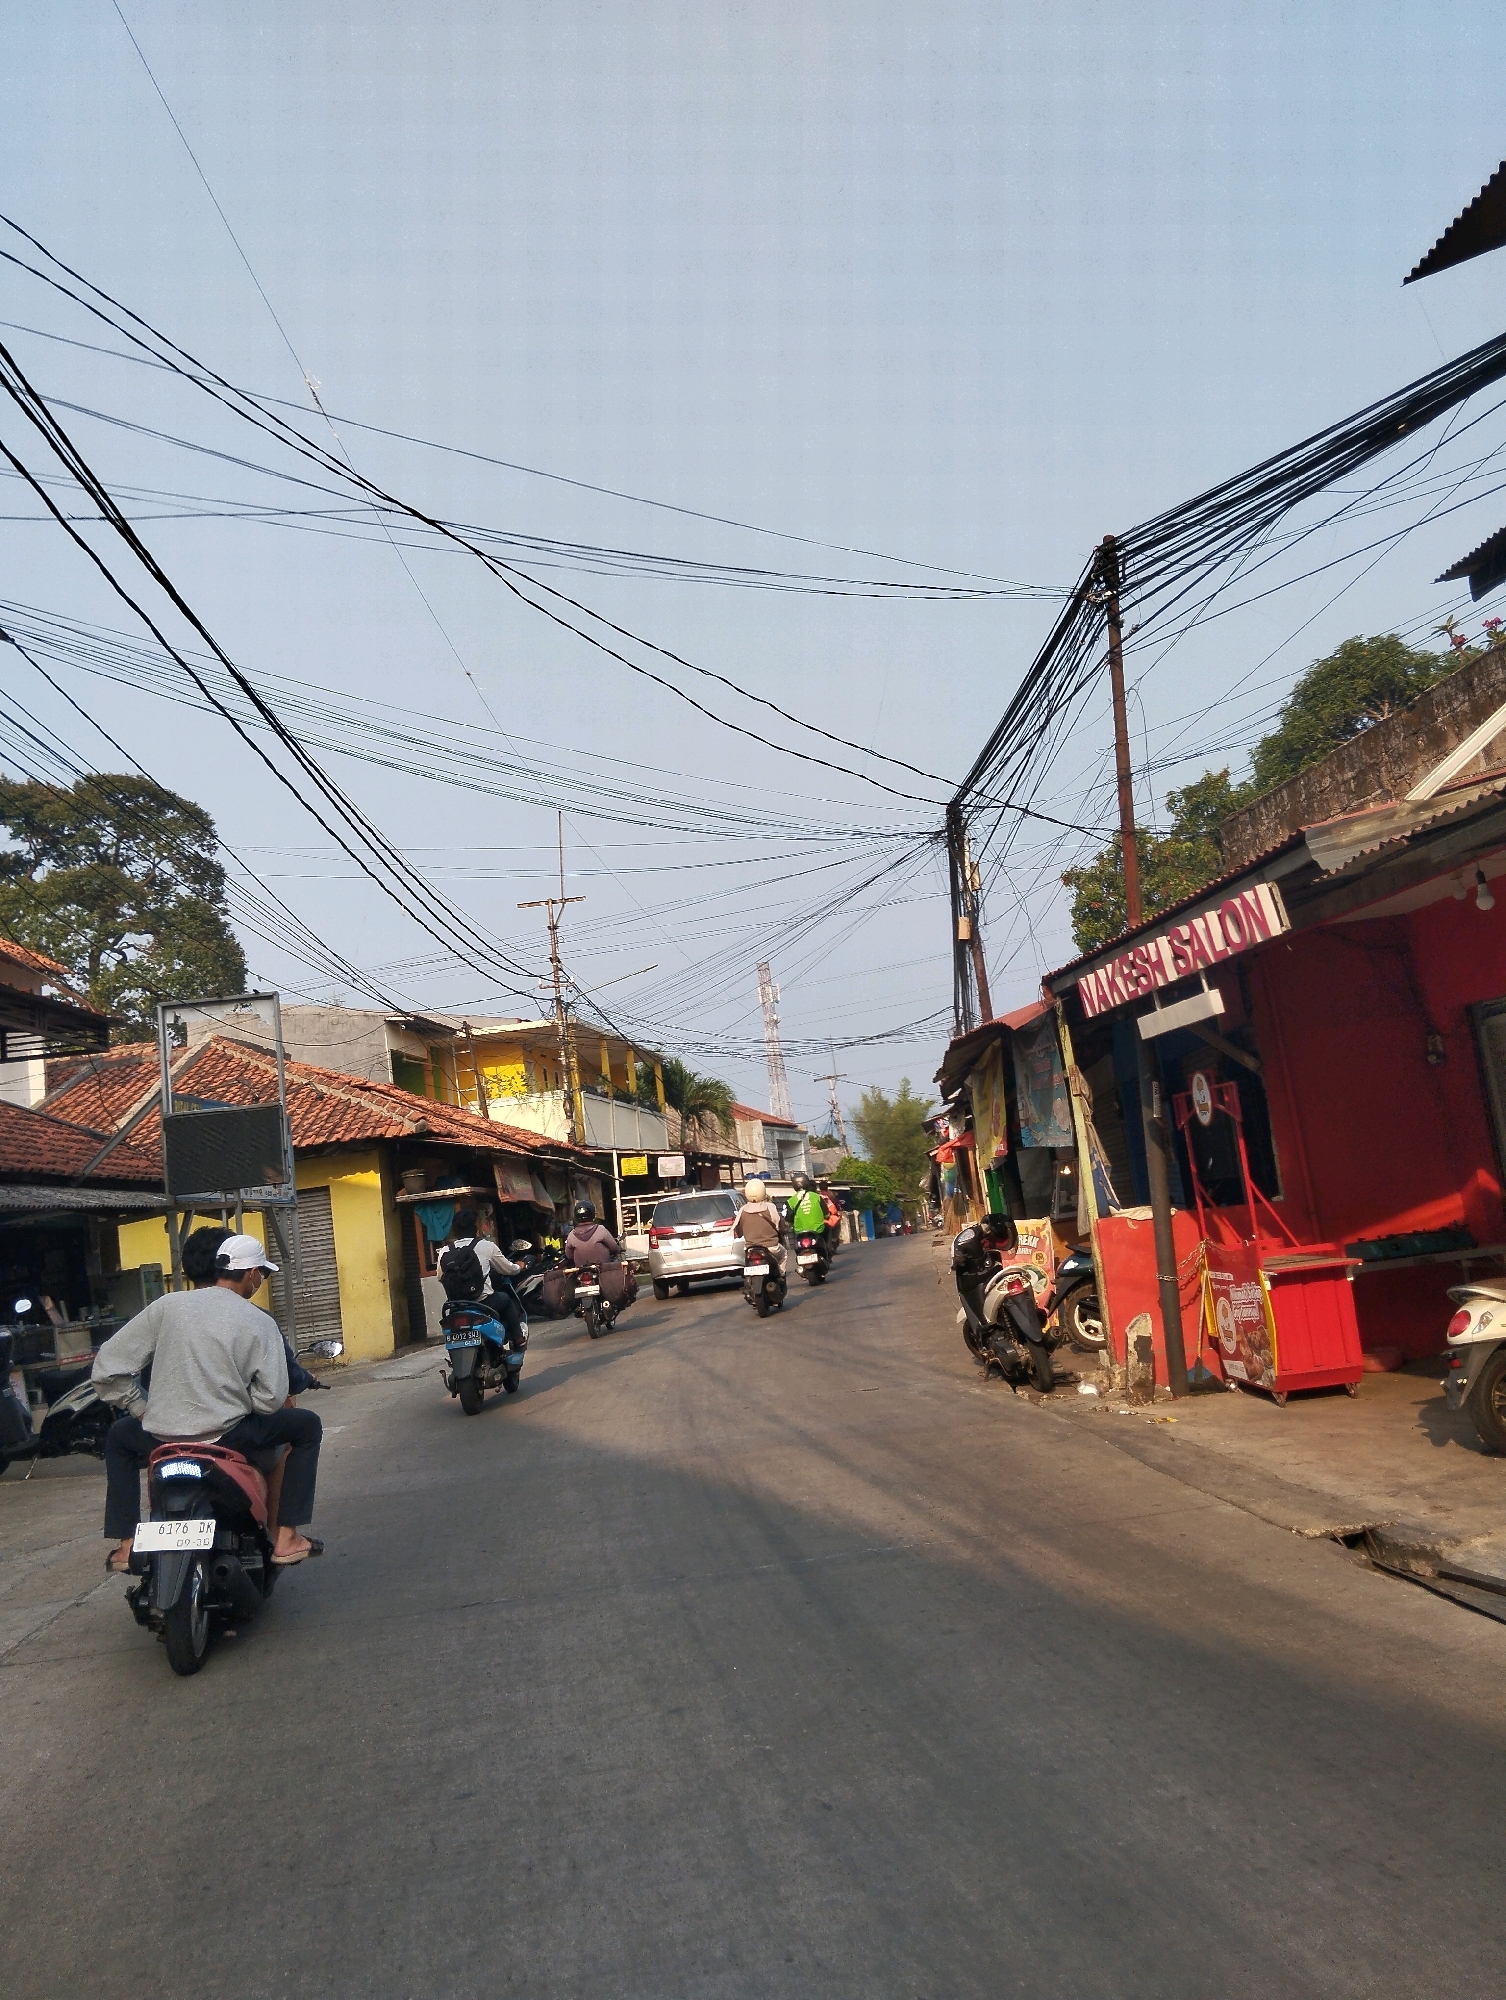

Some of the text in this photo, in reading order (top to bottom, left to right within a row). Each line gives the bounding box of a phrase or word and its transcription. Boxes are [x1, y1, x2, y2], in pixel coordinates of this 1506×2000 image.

[1078, 887, 1271, 1017] NAKESH SALON
[136, 1521, 213, 1536] F 6176 DK
